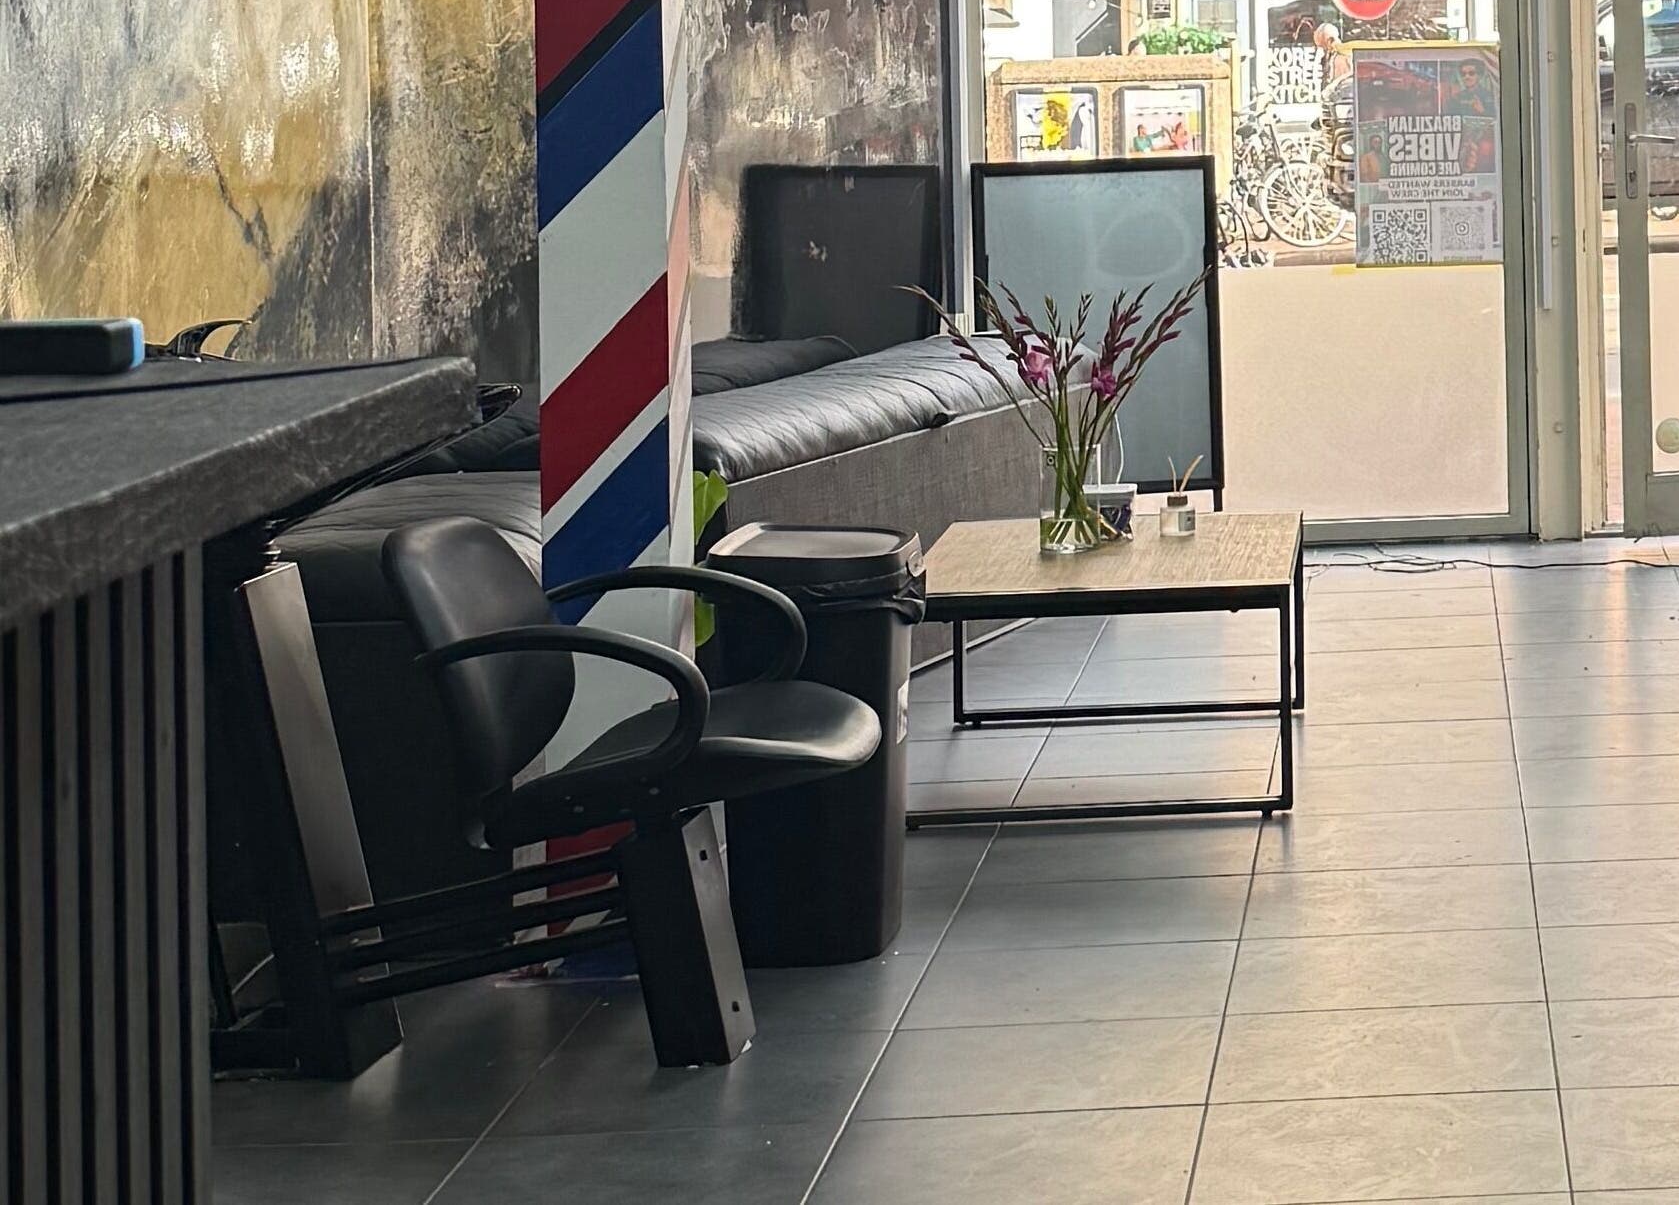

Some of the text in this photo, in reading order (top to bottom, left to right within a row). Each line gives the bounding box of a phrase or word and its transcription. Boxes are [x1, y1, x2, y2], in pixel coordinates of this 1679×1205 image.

[1268, 47, 1325, 67] KOREA
[1268, 65, 1324, 86] STREE
[1269, 83, 1321, 104] KITCH
